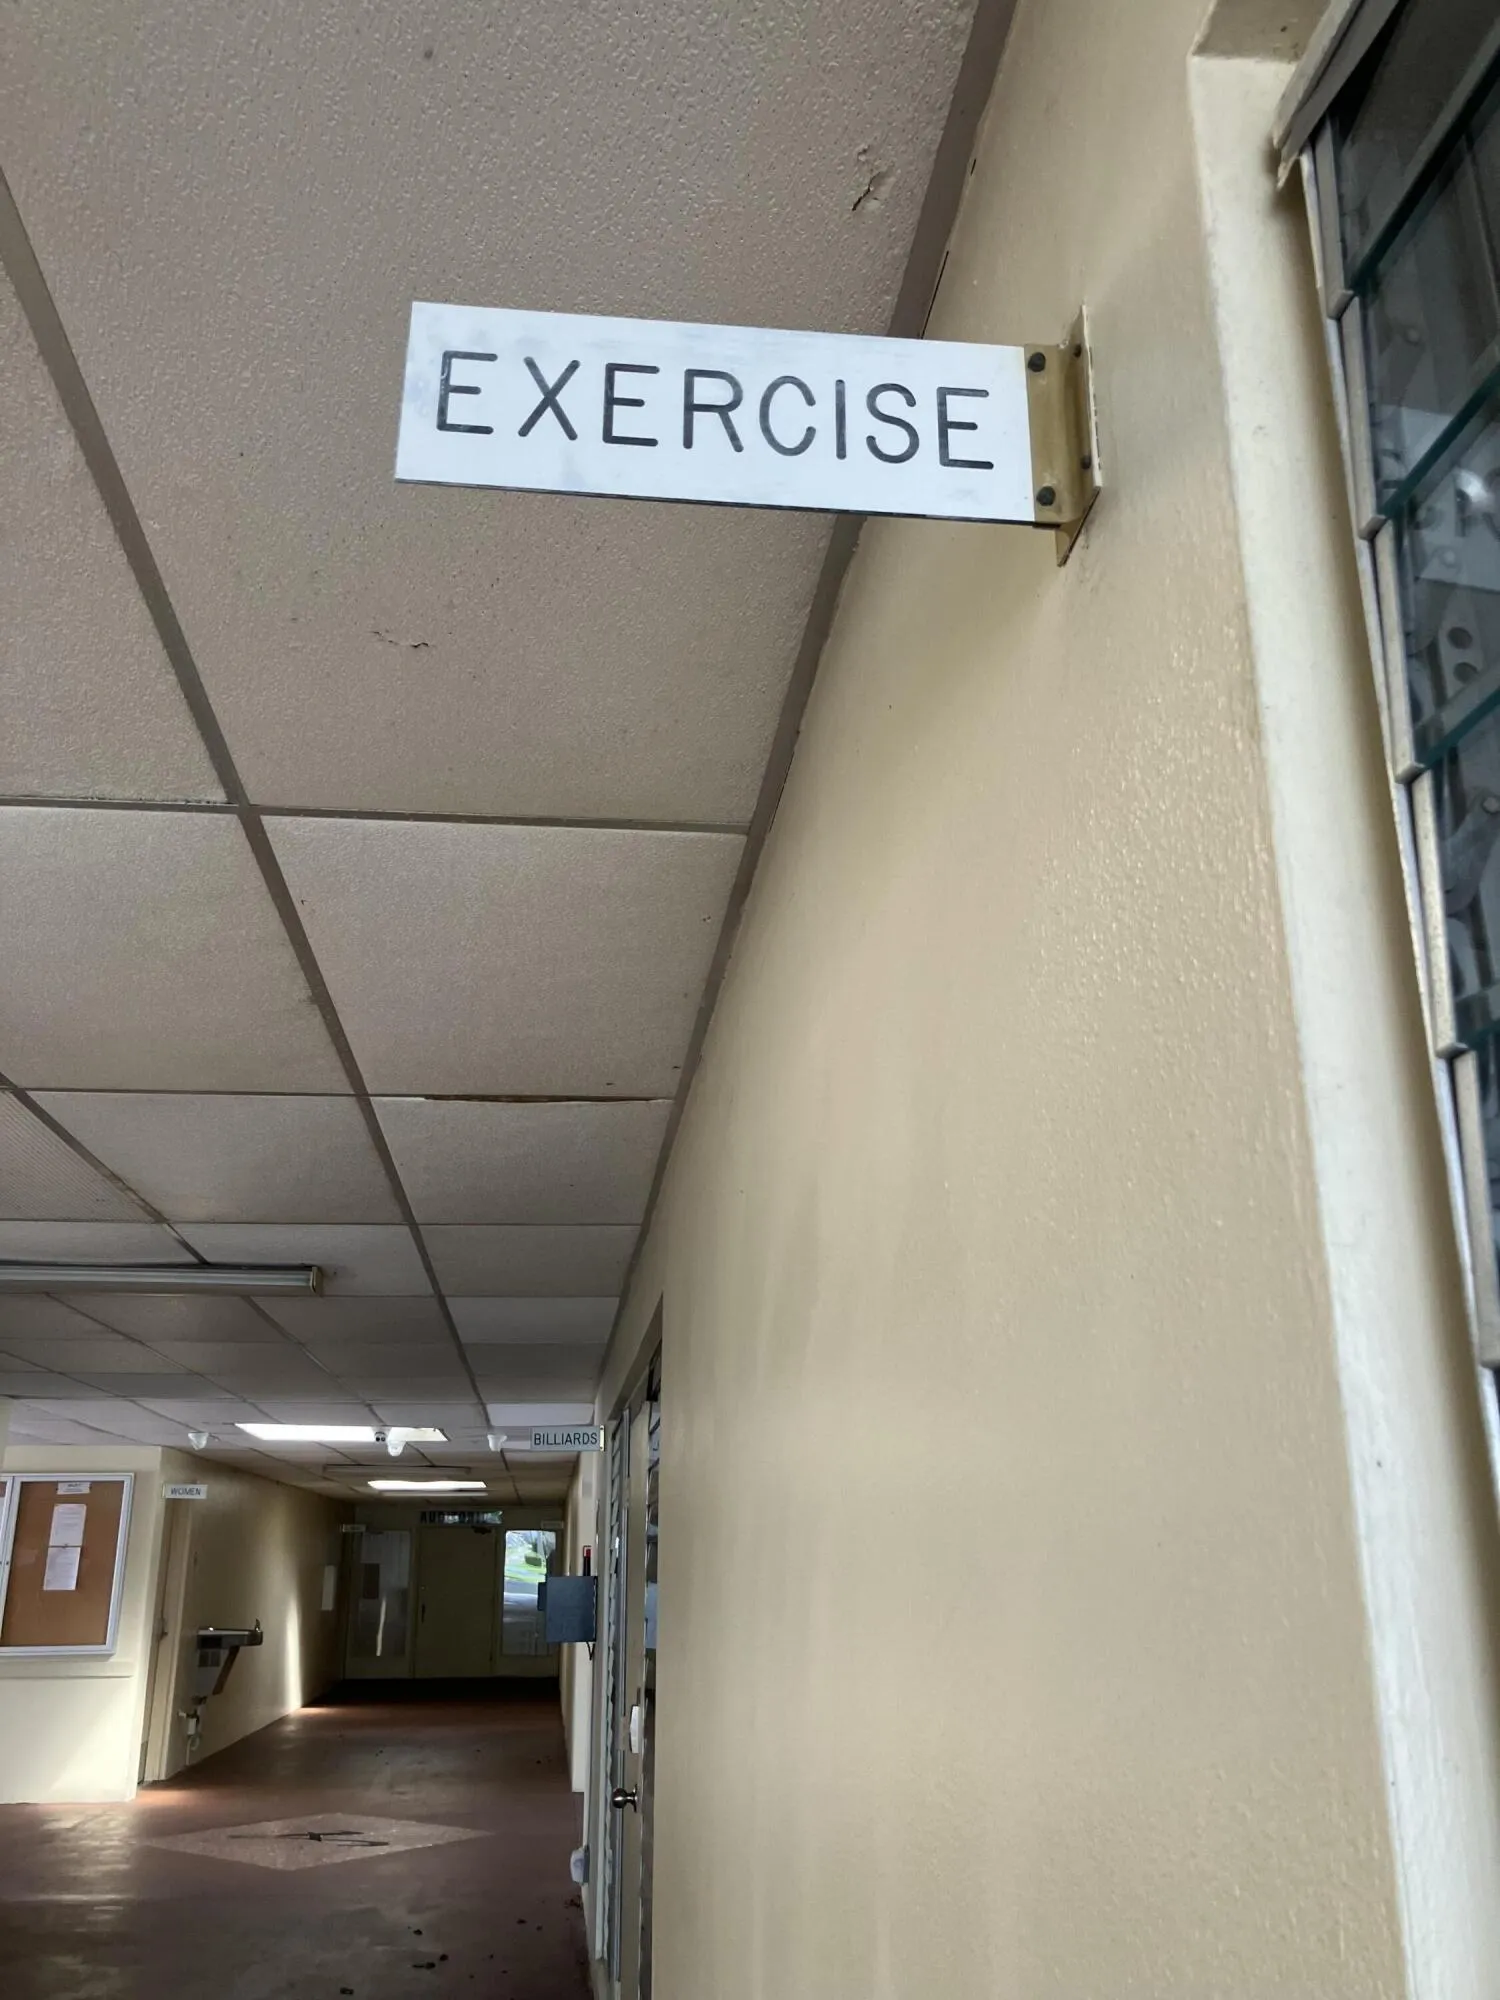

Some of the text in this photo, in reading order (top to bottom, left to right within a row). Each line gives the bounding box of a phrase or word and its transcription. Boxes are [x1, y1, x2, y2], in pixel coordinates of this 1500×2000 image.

[435, 349, 994, 470] EXERCISE
[533, 1432, 598, 1446] BILLIARDS
[170, 1486, 201, 1496] WOMEN
